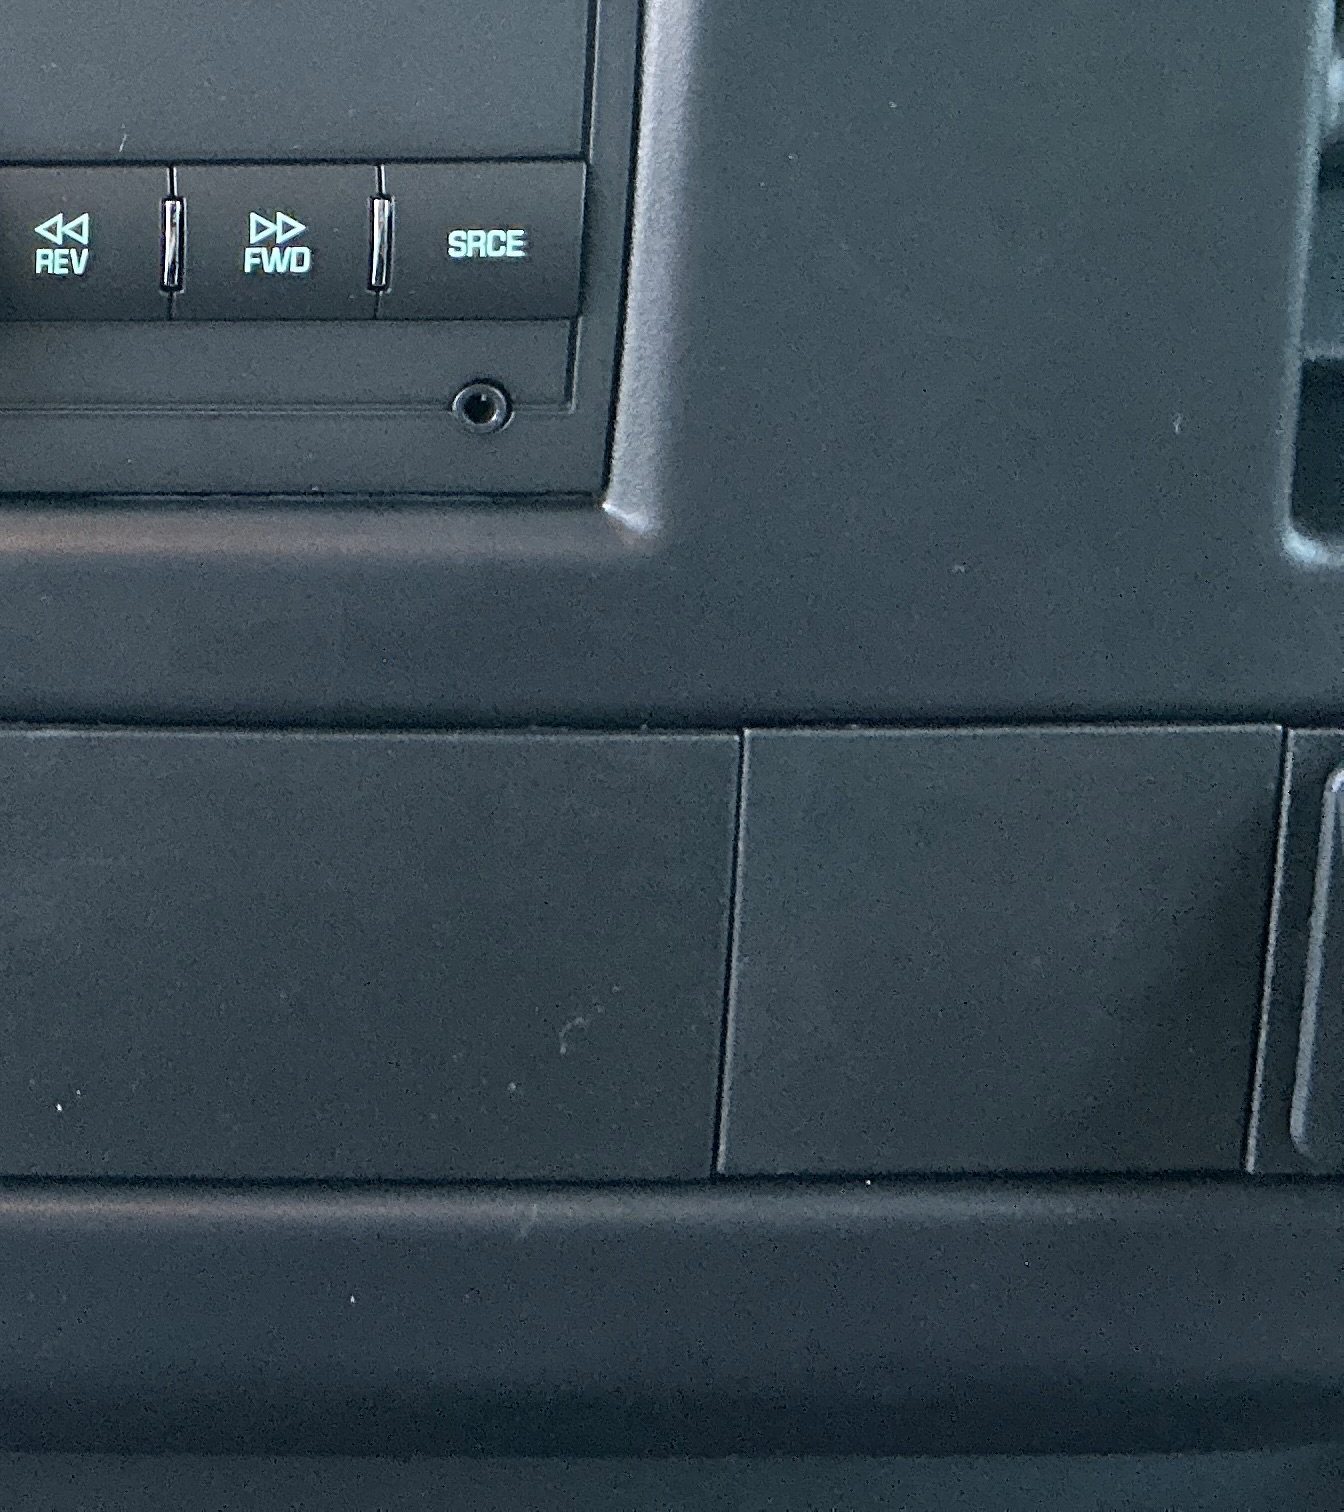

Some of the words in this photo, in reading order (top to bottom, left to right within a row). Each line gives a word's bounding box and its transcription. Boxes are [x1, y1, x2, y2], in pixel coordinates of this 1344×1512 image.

[448, 230, 526, 257] SRCE
[36, 248, 88, 274] REV
[245, 247, 311, 272] FWD
